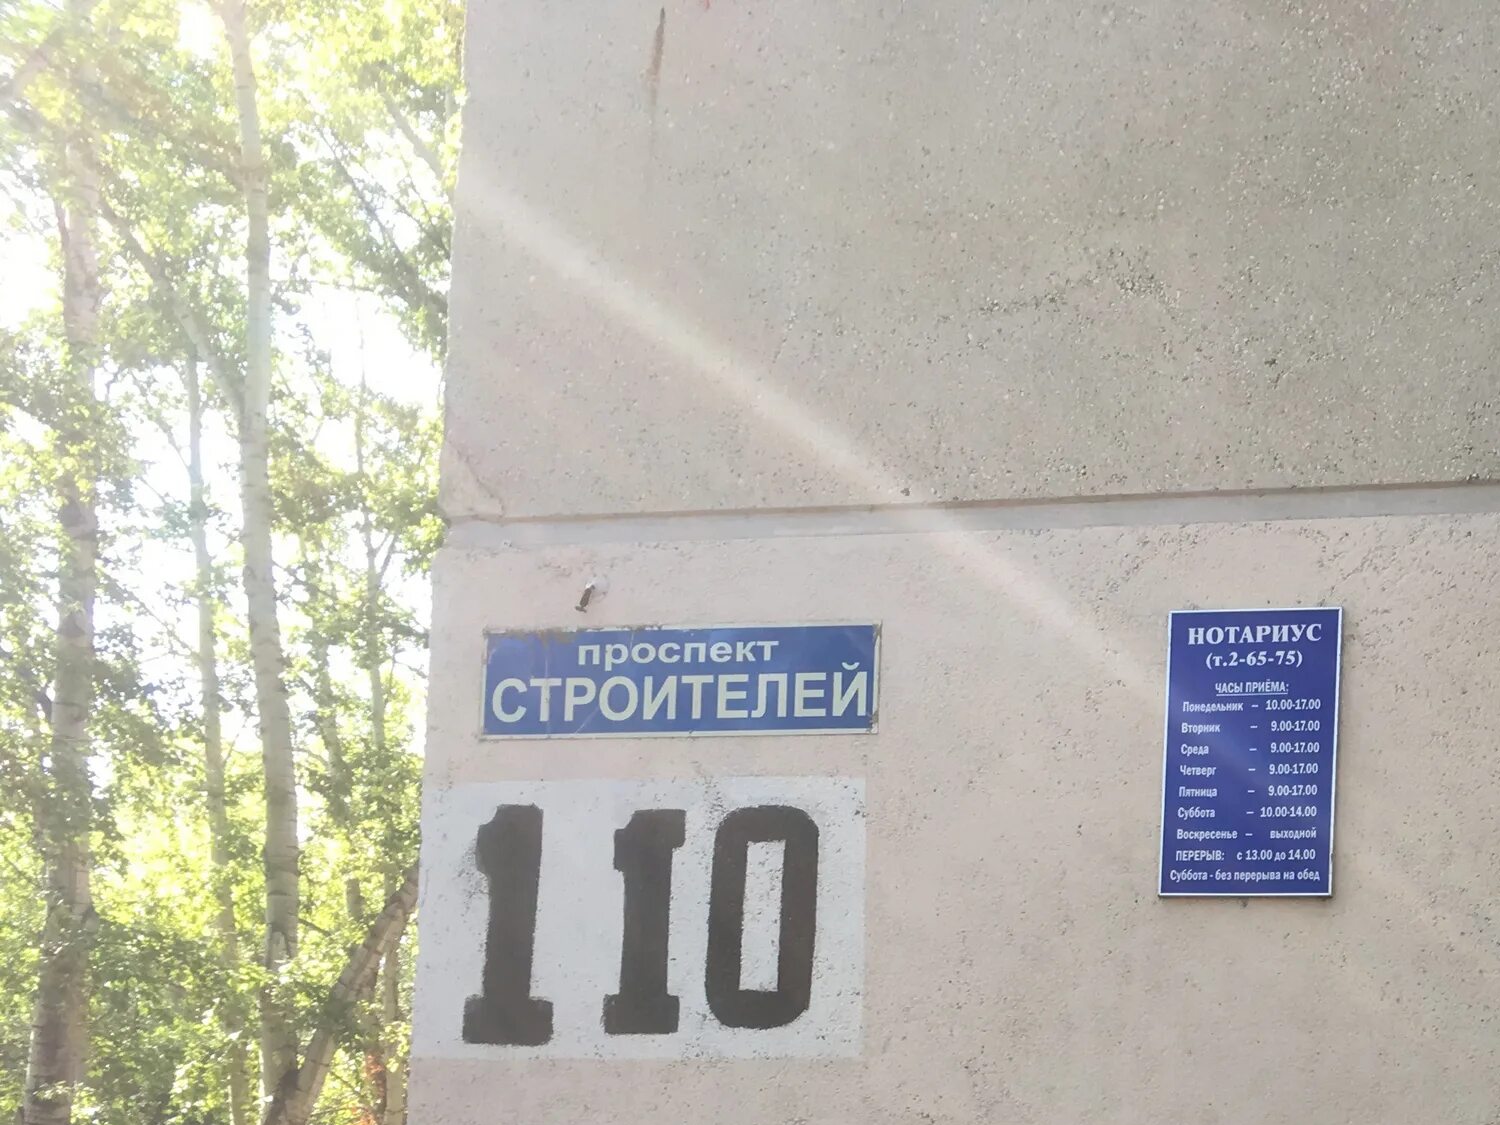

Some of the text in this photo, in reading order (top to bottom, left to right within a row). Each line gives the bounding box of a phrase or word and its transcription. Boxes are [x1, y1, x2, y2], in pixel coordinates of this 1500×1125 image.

[1188, 624, 1321, 645] НОТАРИУС
[578, 638, 779, 671] проспект
[1206, 651, 1303, 669] (т.2-65-75)
[491, 662, 868, 723] СТРОИТЕЛЕЙ
[1216, 679, 1289, 693] ЧАСЫ ПРИЁМА:
[1183, 701, 1243, 713] Понедельник
[1265, 699, 1321, 710] 10.00-17.00
[1181, 723, 1220, 735] Вторник
[1271, 721, 1320, 731] 9.00-17.00
[1181, 744, 1209, 756] Среда
[1271, 742, 1319, 753] 9.00-17.00
[1180, 765, 1216, 777] Четверг
[1269, 763, 1318, 774] 9.00-17.00
[1179, 786, 1217, 798] Пятница
[1268, 785, 1317, 796] 9.00-17.00
[1178, 807, 1215, 820] Суббота
[1260, 806, 1317, 817] 10.00-14.00
[1177, 829, 1237, 841] Воскресенье
[1270, 827, 1316, 840] выходной
[1176, 850, 1225, 861] ПЕРЕРЫВ:
[1245, 850, 1272, 860] 13.00
[1274, 851, 1286, 861] до
[1288, 849, 1315, 860] 14.00
[1170, 870, 1207, 882] Суббота
[1215, 869, 1232, 880] без
[1234, 871, 1280, 882] перерыва
[1283, 871, 1294, 880] на
[1297, 868, 1320, 881] обед
[462, 804, 819, 1045] 110
